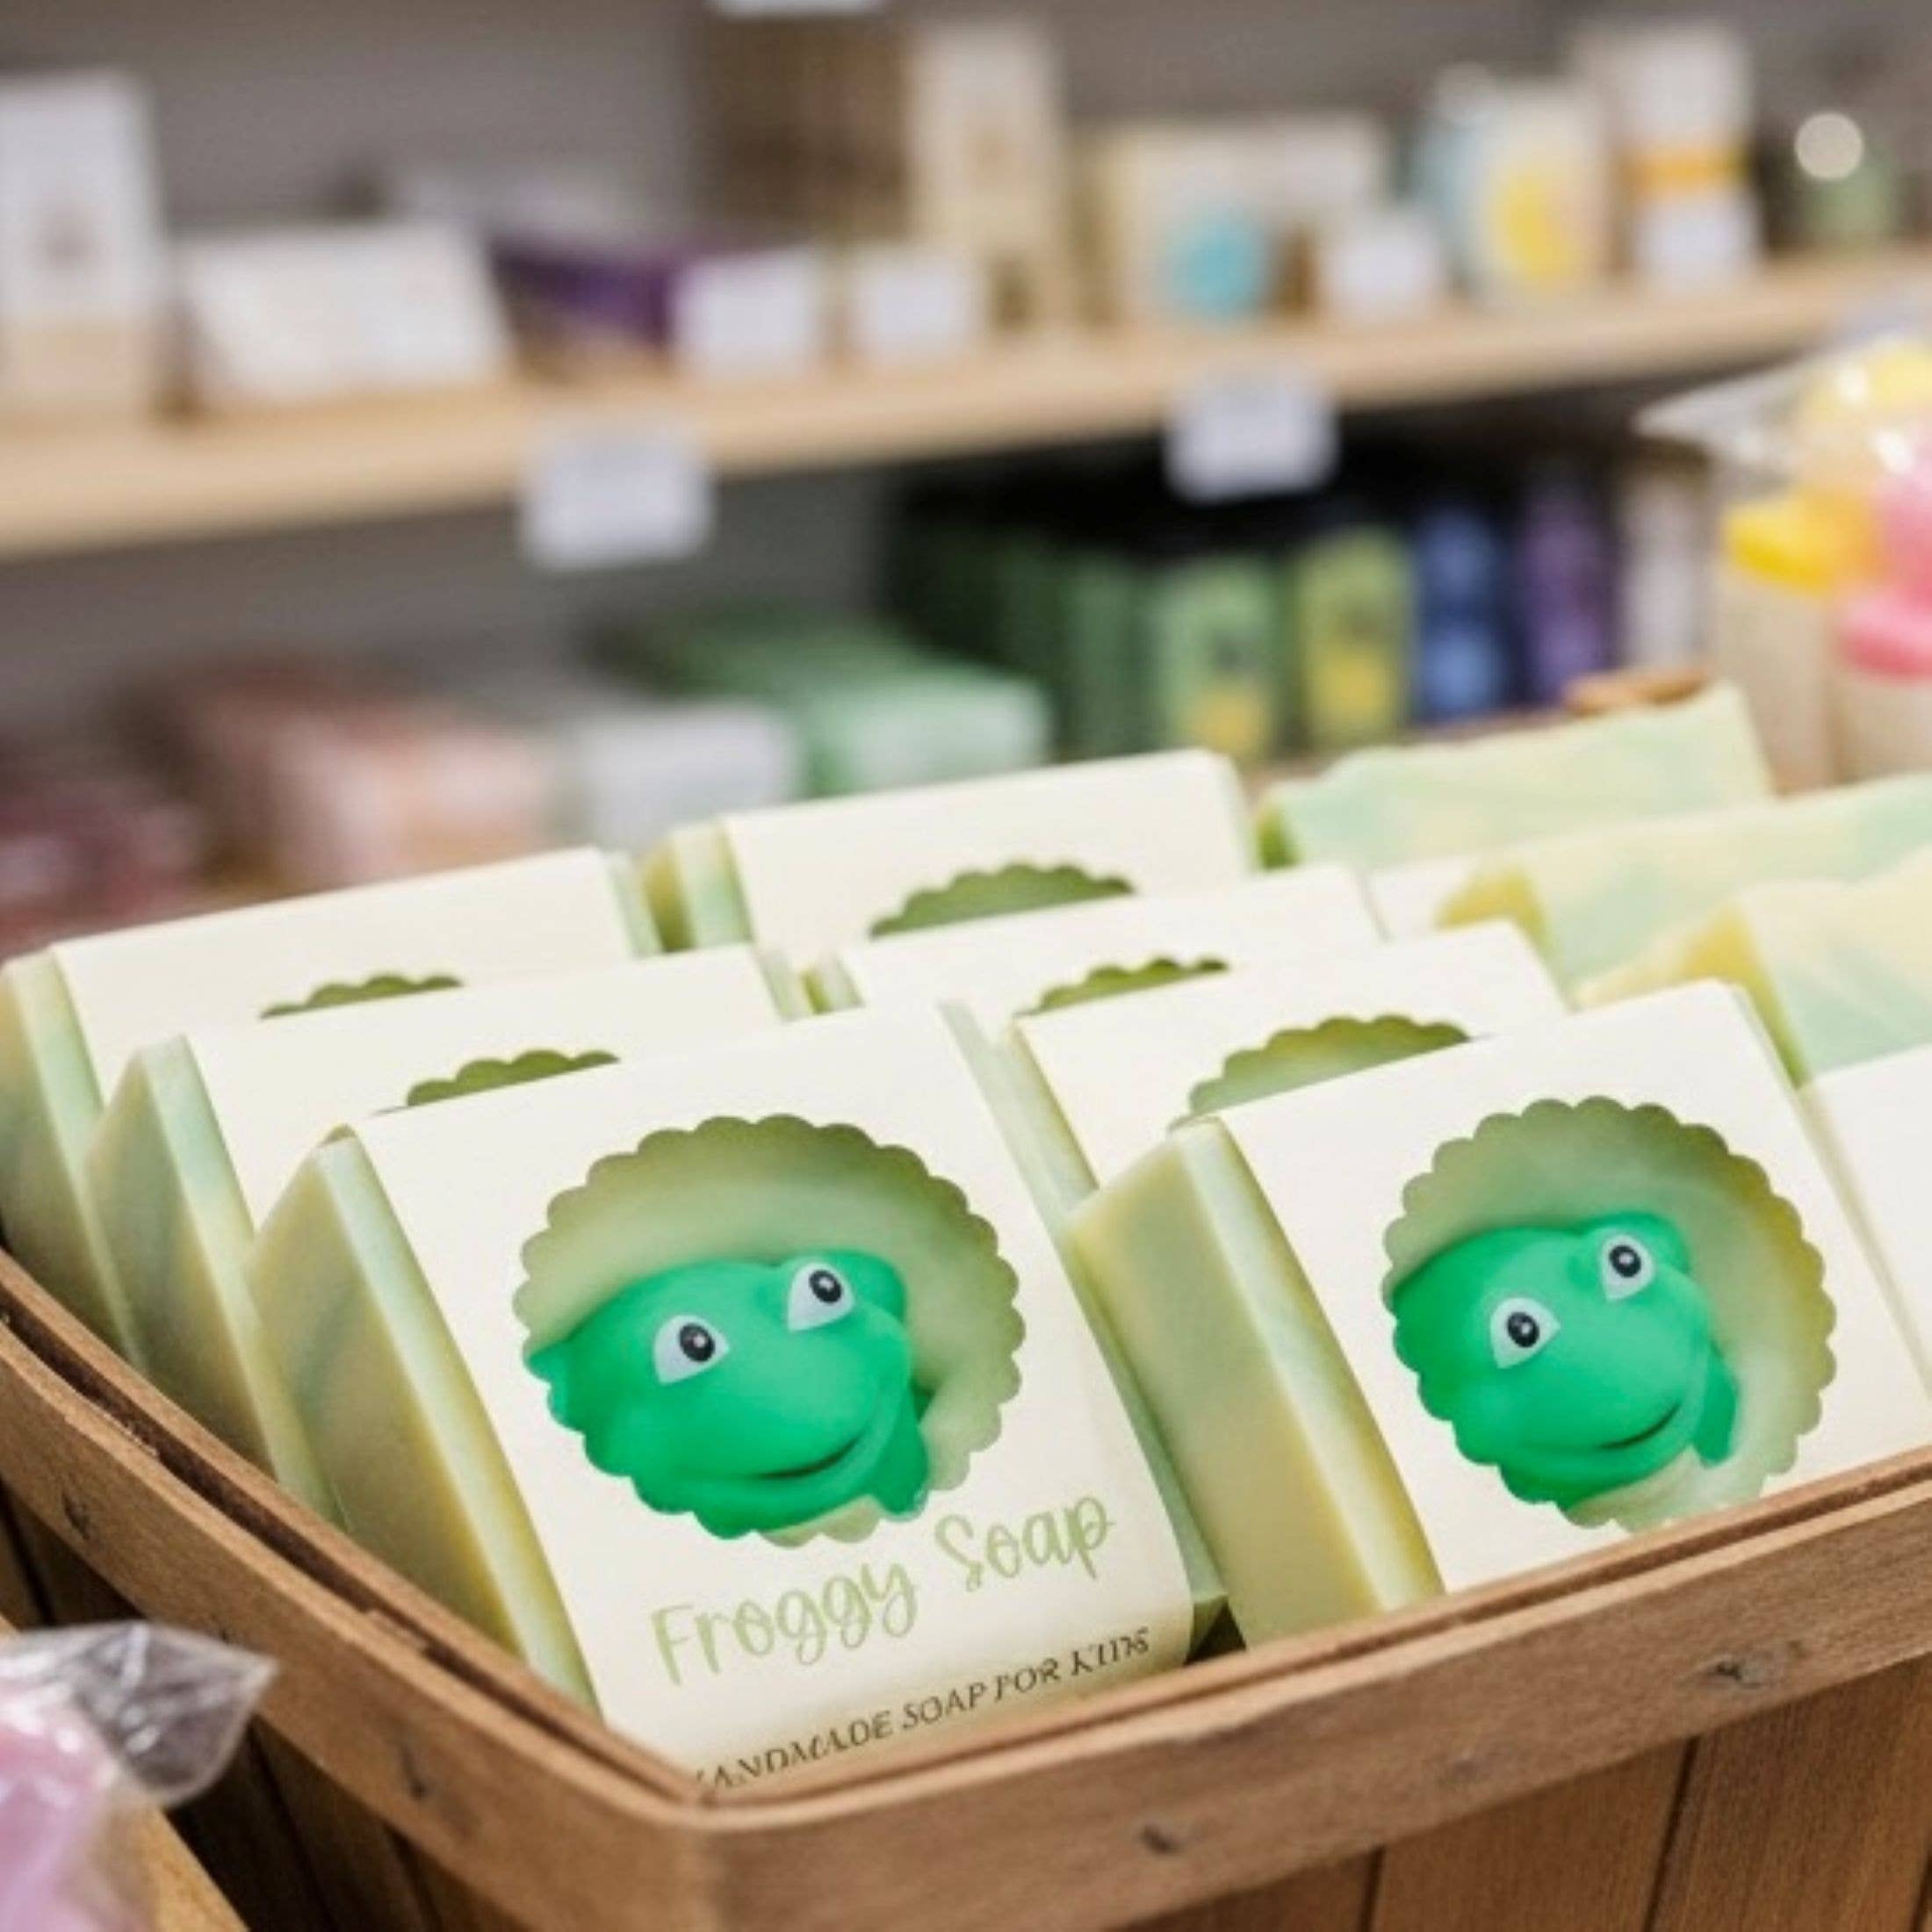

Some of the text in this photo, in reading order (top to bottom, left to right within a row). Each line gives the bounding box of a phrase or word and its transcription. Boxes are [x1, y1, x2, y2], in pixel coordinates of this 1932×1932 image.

[651, 1496, 1114, 1686] Froggy Soap
[696, 1710, 894, 1790] ANDMADE
[902, 1681, 988, 1730] SOAP
[993, 1657, 1061, 1703] FOR
